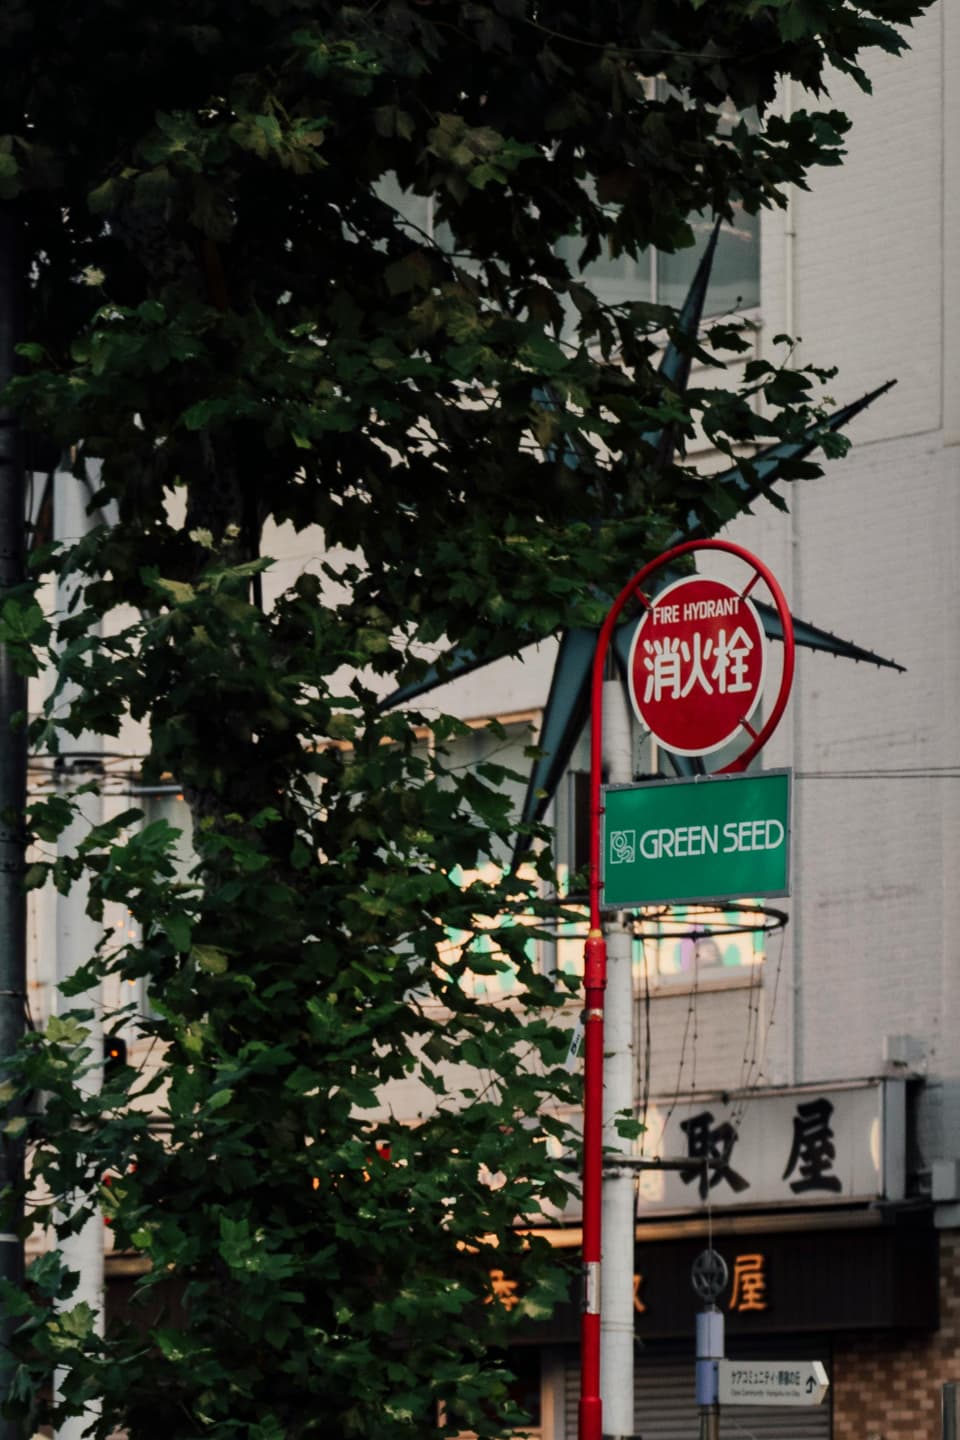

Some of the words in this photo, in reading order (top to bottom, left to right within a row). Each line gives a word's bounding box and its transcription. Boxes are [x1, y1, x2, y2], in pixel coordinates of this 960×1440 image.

[652, 604, 680, 625] FIRE
[683, 596, 741, 621] HYDRANT
[642, 626, 754, 704] 消火栓
[639, 824, 719, 860] GREEN
[722, 819, 785, 853] SEED
